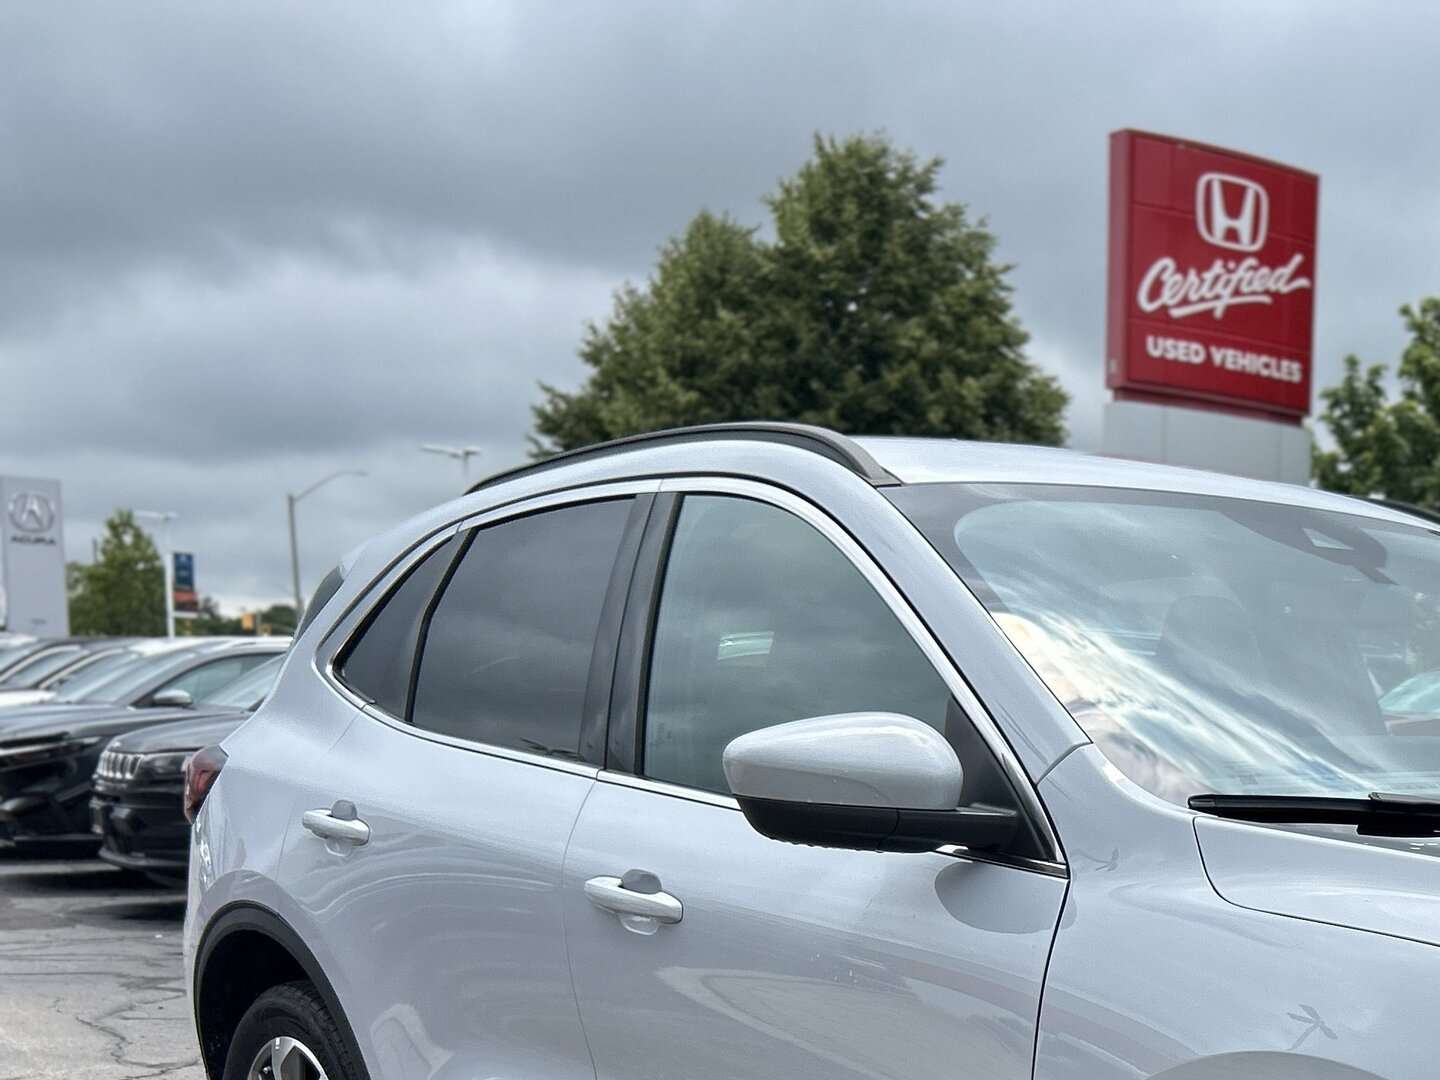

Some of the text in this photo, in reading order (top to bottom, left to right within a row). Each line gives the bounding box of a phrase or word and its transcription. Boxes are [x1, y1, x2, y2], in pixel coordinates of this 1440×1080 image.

[1137, 253, 1310, 319] Certified
[1146, 335, 1303, 383] USED VEHICLES
[10, 535, 56, 546] ACURA
